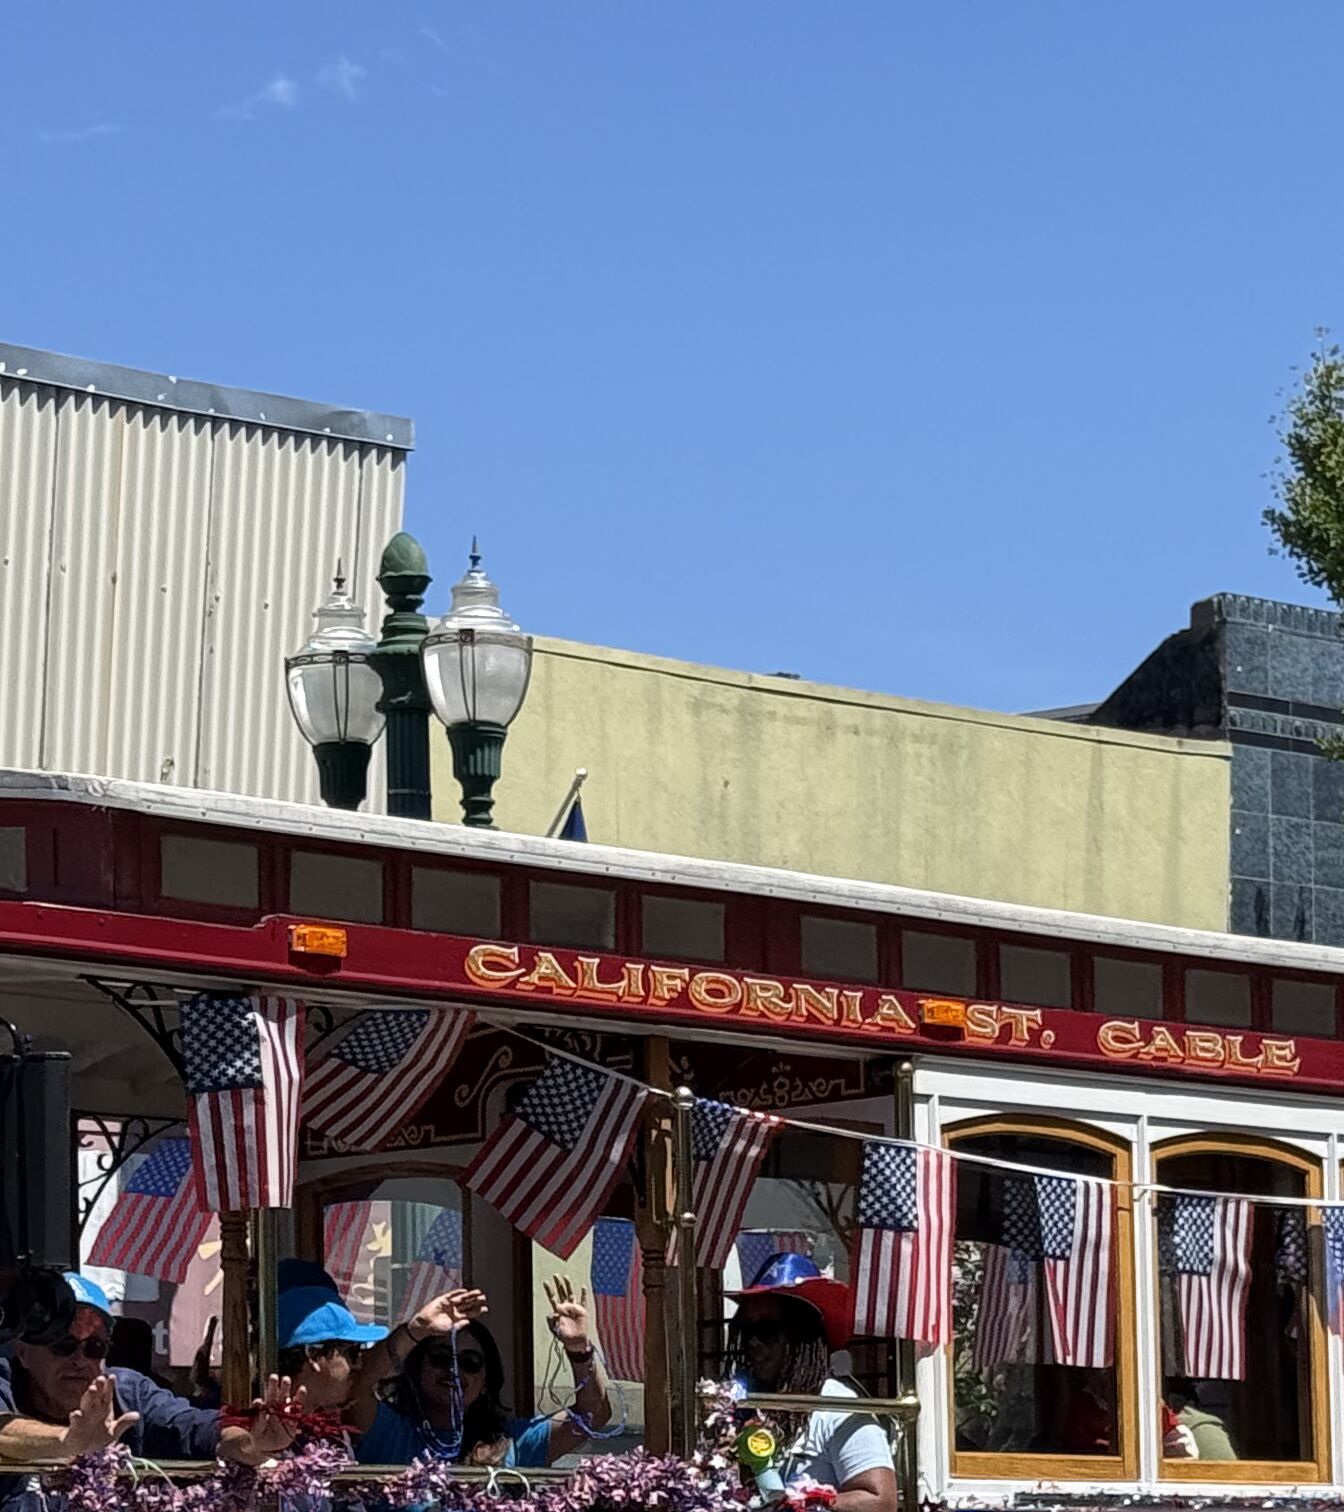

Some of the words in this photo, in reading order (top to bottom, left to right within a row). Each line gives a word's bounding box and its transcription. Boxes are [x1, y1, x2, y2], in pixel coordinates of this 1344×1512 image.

[464, 944, 917, 1032] CALIFORNIA
[964, 1004, 1055, 1050] ST.
[1097, 1021, 1301, 1075] CABLE
